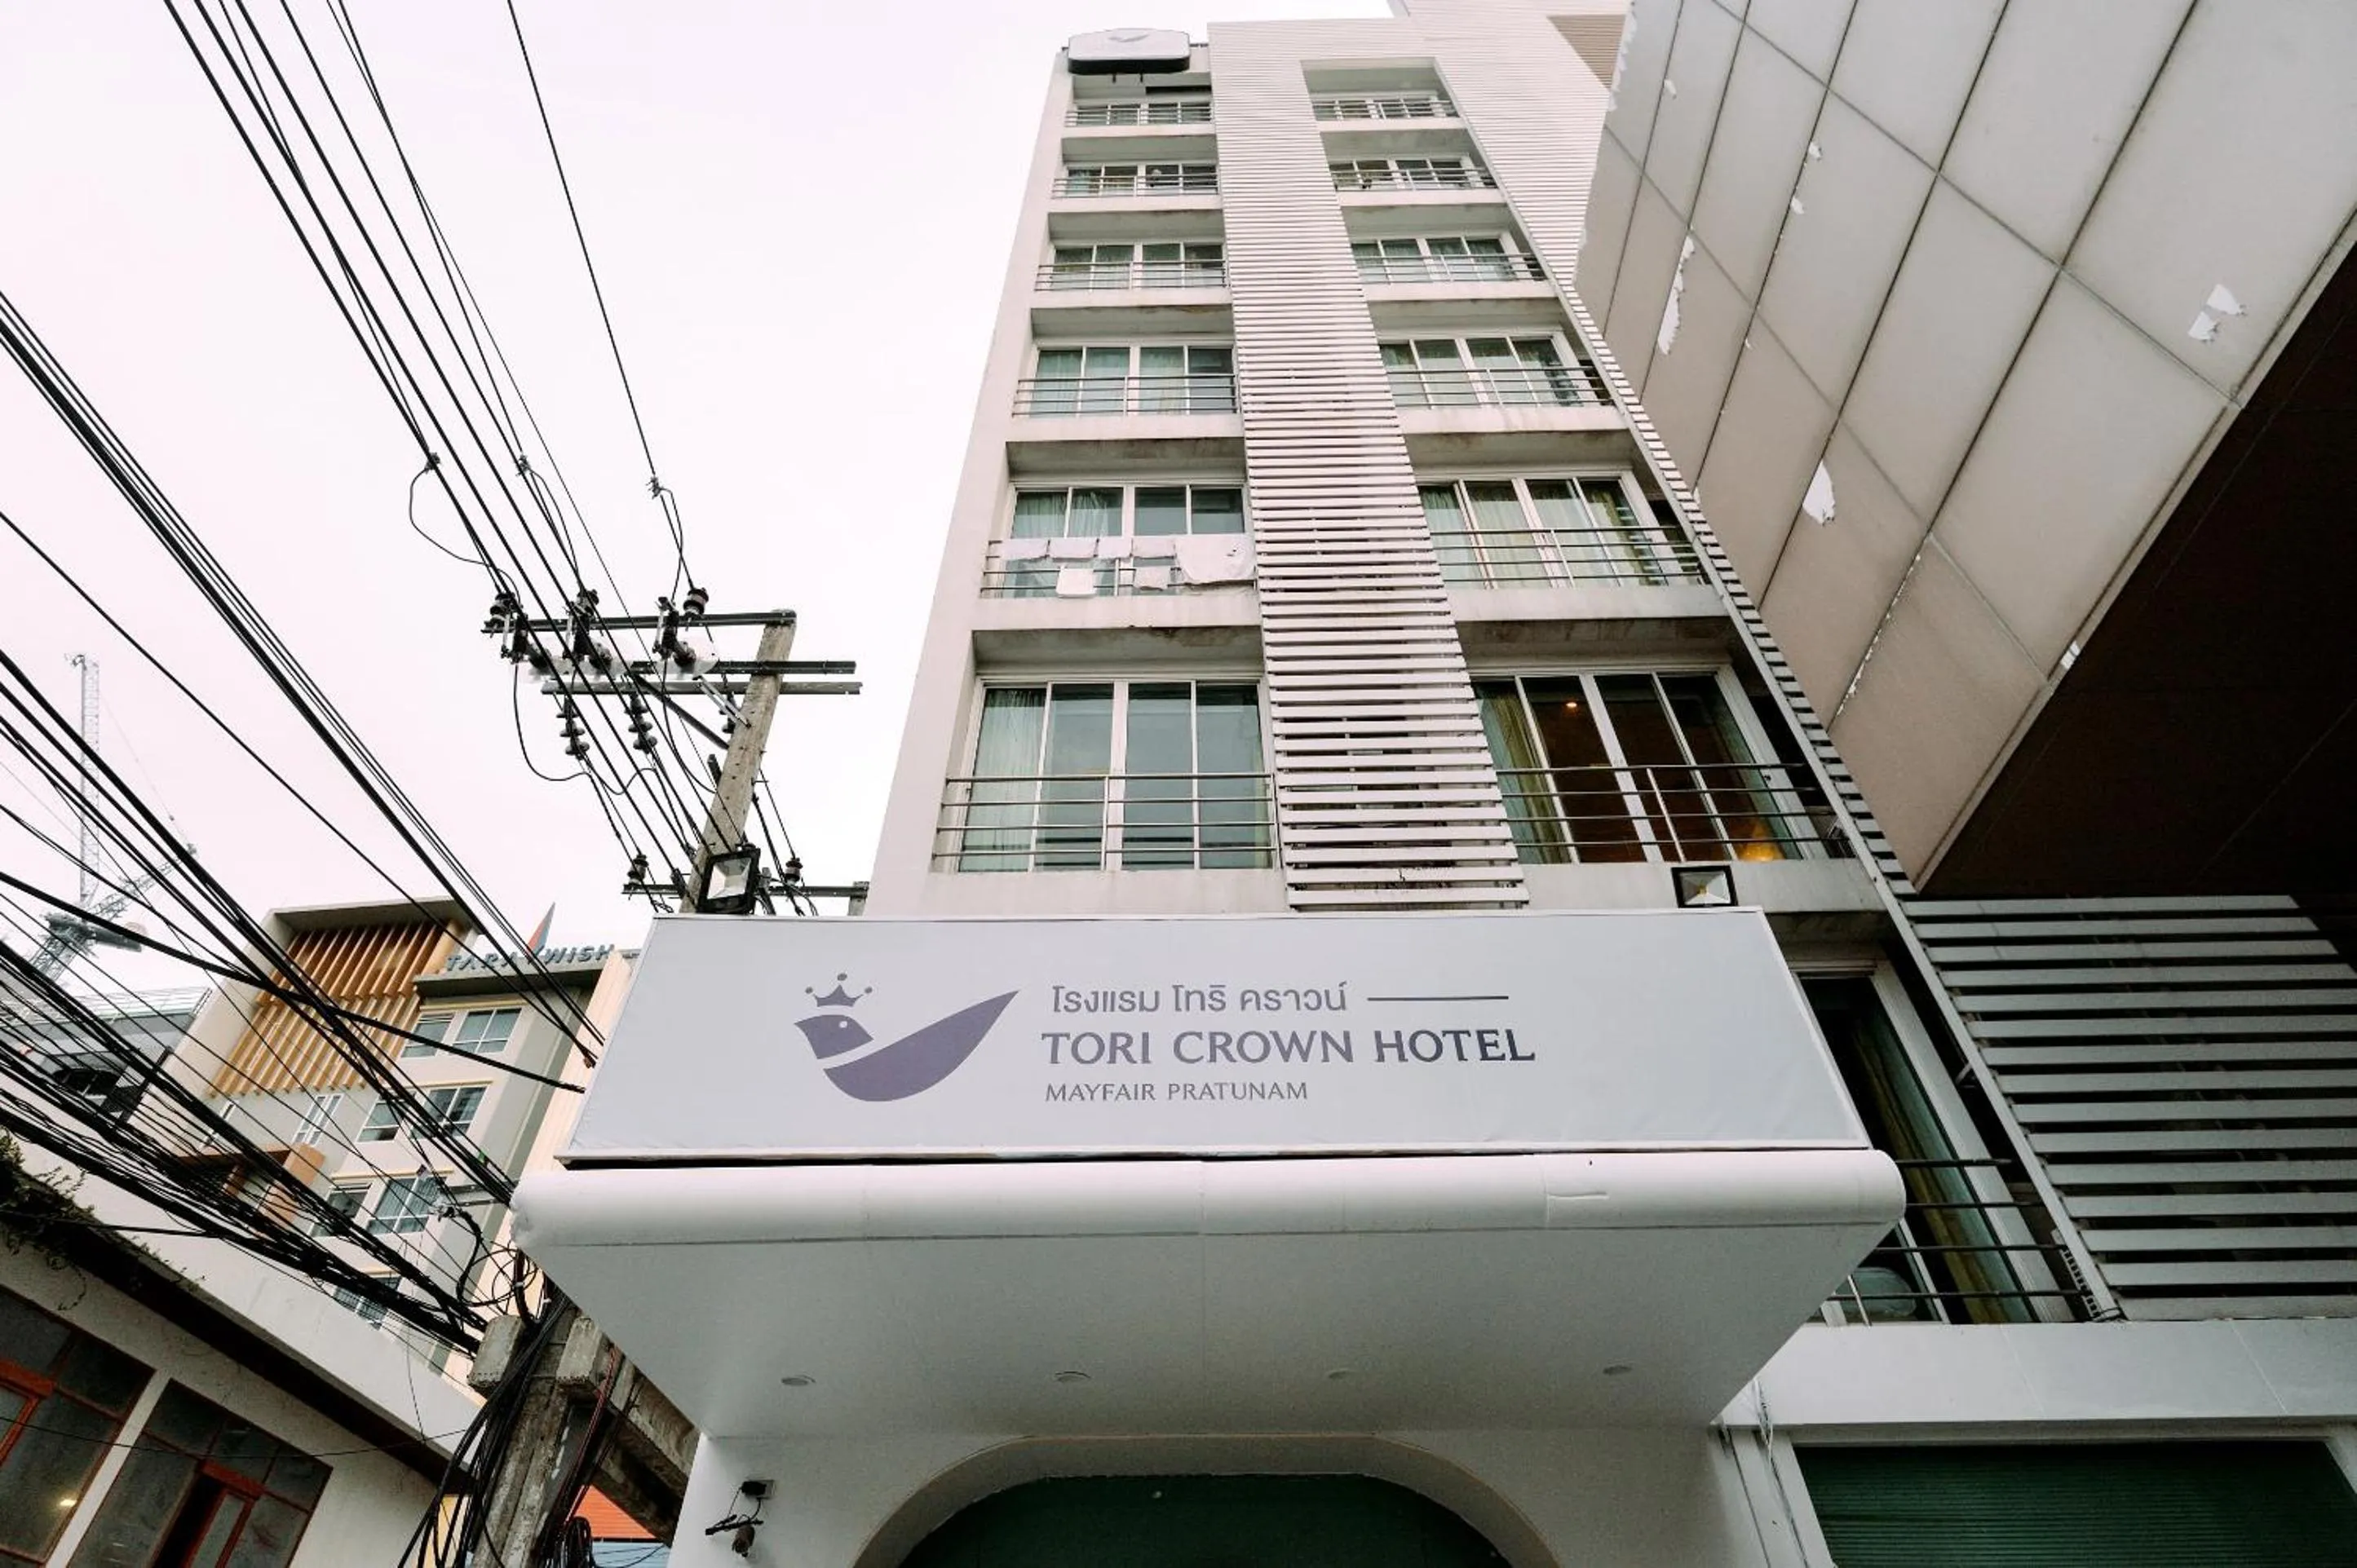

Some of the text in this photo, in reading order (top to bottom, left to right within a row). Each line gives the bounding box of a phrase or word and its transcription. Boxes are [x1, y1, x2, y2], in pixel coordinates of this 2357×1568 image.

[1052, 980, 1347, 1013] โรงแรม โทริ คราวน์
[1041, 1028, 1537, 1065] TORI CROWN HOTEL
[1046, 1082, 1307, 1102] MAYFAIR PRATUNAM
